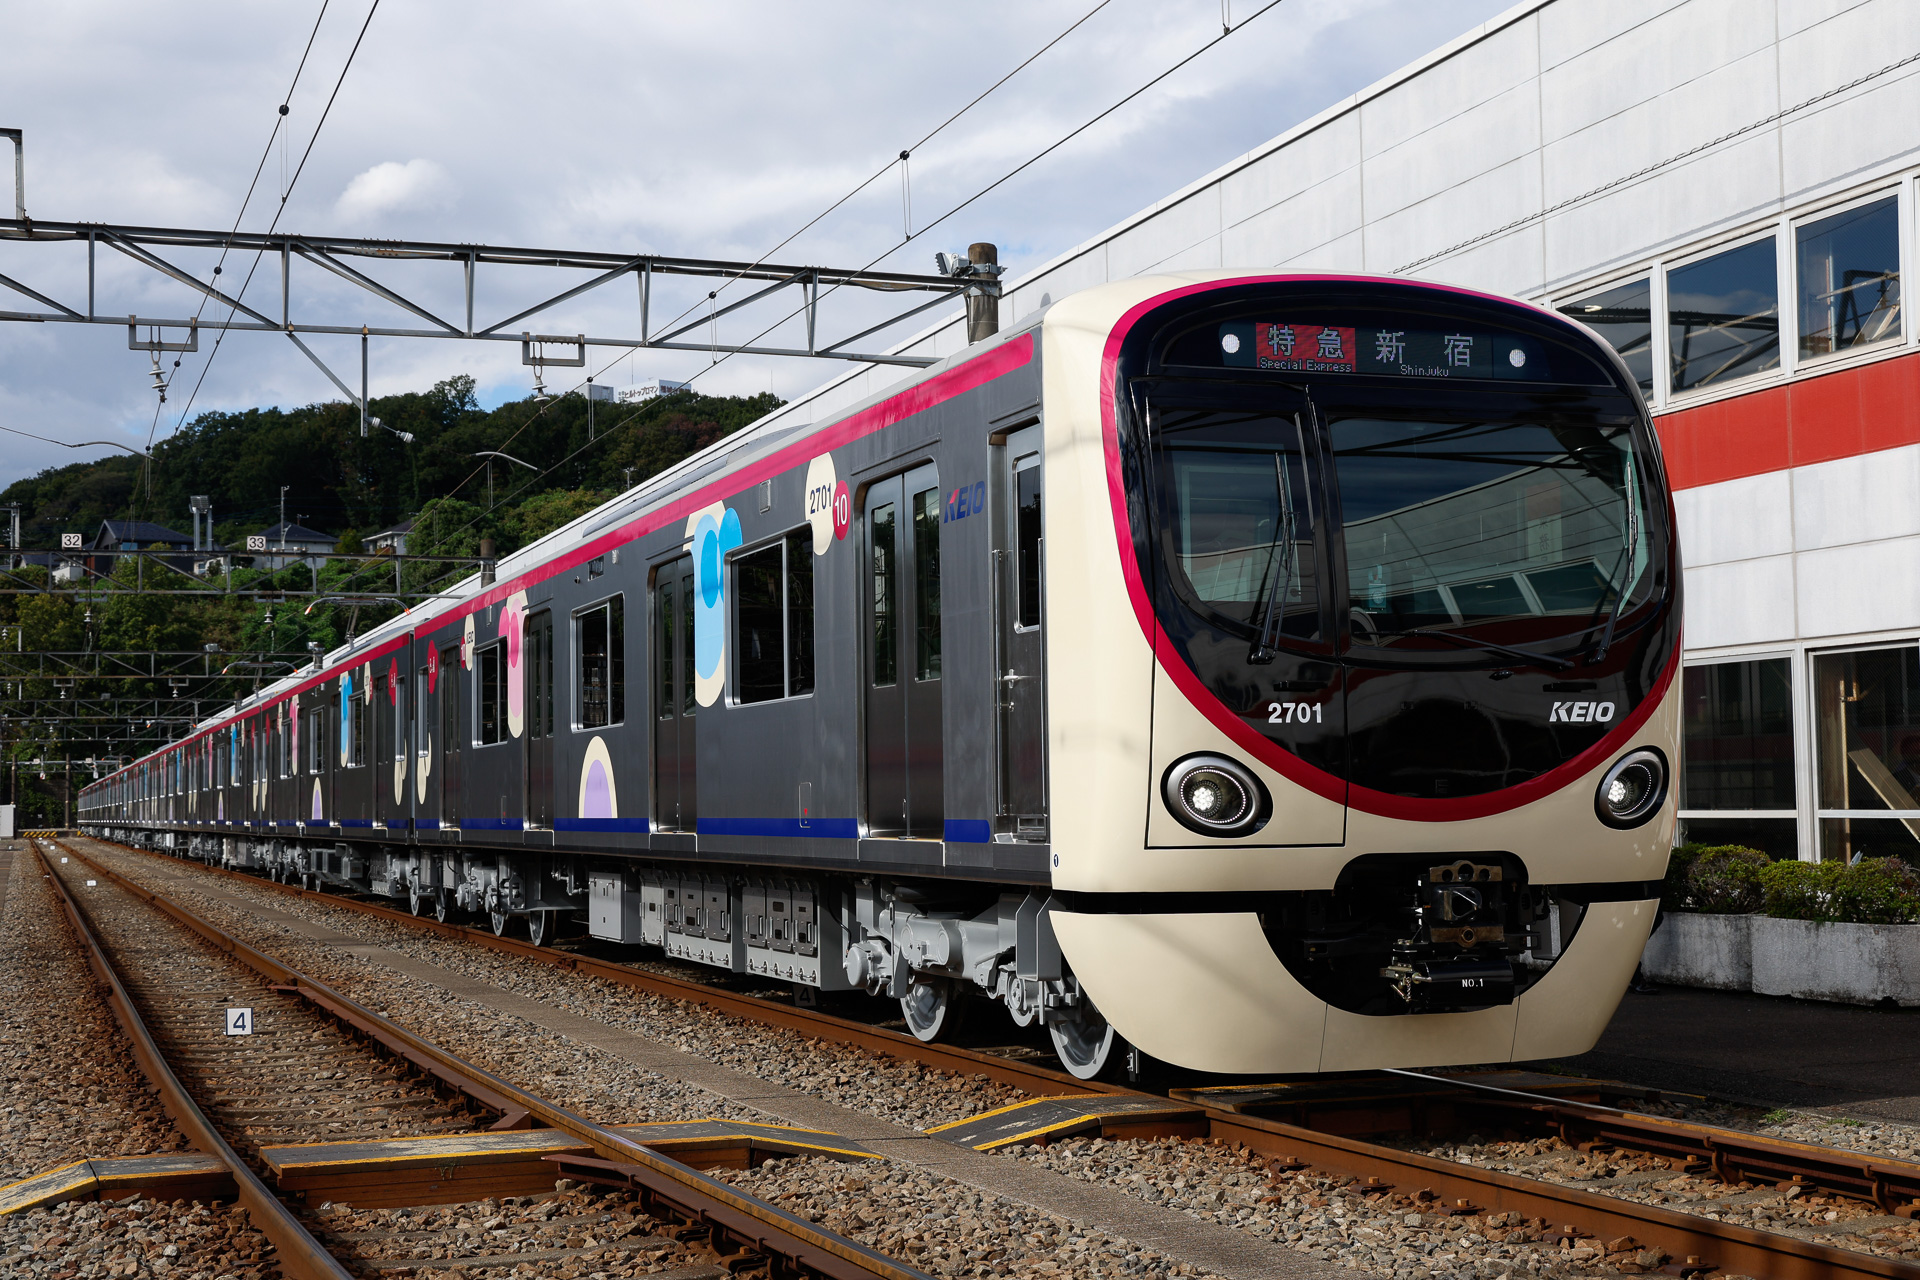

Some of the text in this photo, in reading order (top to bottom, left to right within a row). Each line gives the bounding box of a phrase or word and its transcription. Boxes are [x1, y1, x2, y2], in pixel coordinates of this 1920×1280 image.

[1268, 325, 1344, 358] 特急
[1376, 330, 1473, 367] 新宿
[1260, 357, 1352, 372] Special Express
[1400, 364, 1449, 377] Shinjuku
[809, 482, 832, 514] 2701
[943, 480, 986, 524] KEIO
[834, 494, 848, 527] 10
[64, 535, 80, 546] 32
[249, 537, 264, 549] 33
[1268, 702, 1322, 724] 2701
[1549, 701, 1615, 722] KEIO
[1461, 978, 1484, 988] NO.1
[799, 987, 811, 1003] 4
[233, 1012, 246, 1031] 4
